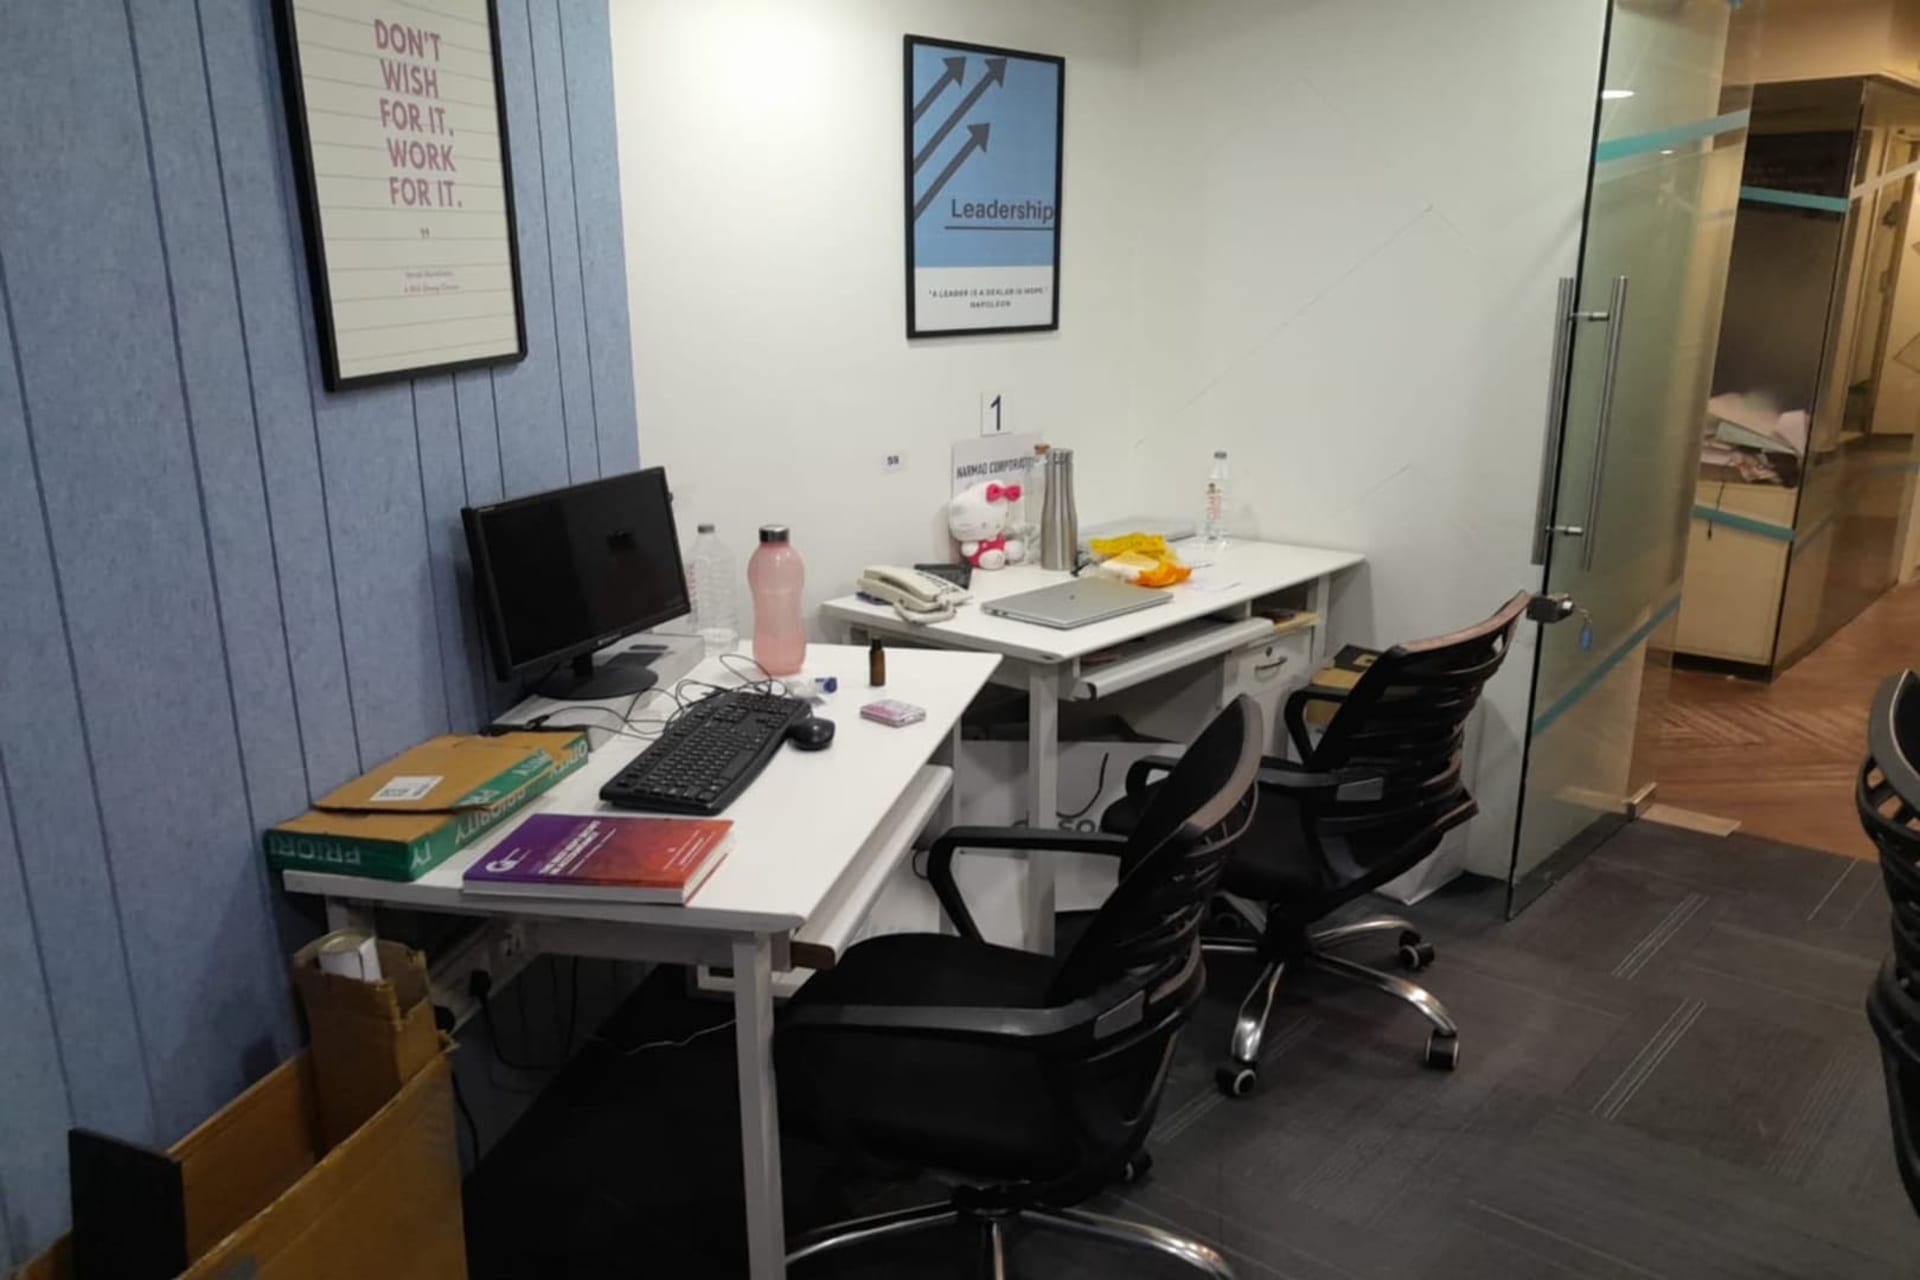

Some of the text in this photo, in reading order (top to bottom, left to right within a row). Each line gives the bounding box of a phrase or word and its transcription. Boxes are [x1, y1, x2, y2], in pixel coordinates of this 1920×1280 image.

[373, 18, 441, 62] DON'T
[379, 58, 439, 99] WISH
[379, 98, 455, 137] FOR IT.
[386, 137, 456, 172] WORK
[388, 176, 463, 208] FOR IT.
[951, 198, 1055, 225] Leadership
[939, 288, 968, 298] LEADER
[970, 299, 1011, 308] NAPOLEON
[990, 394, 1001, 431] 1
